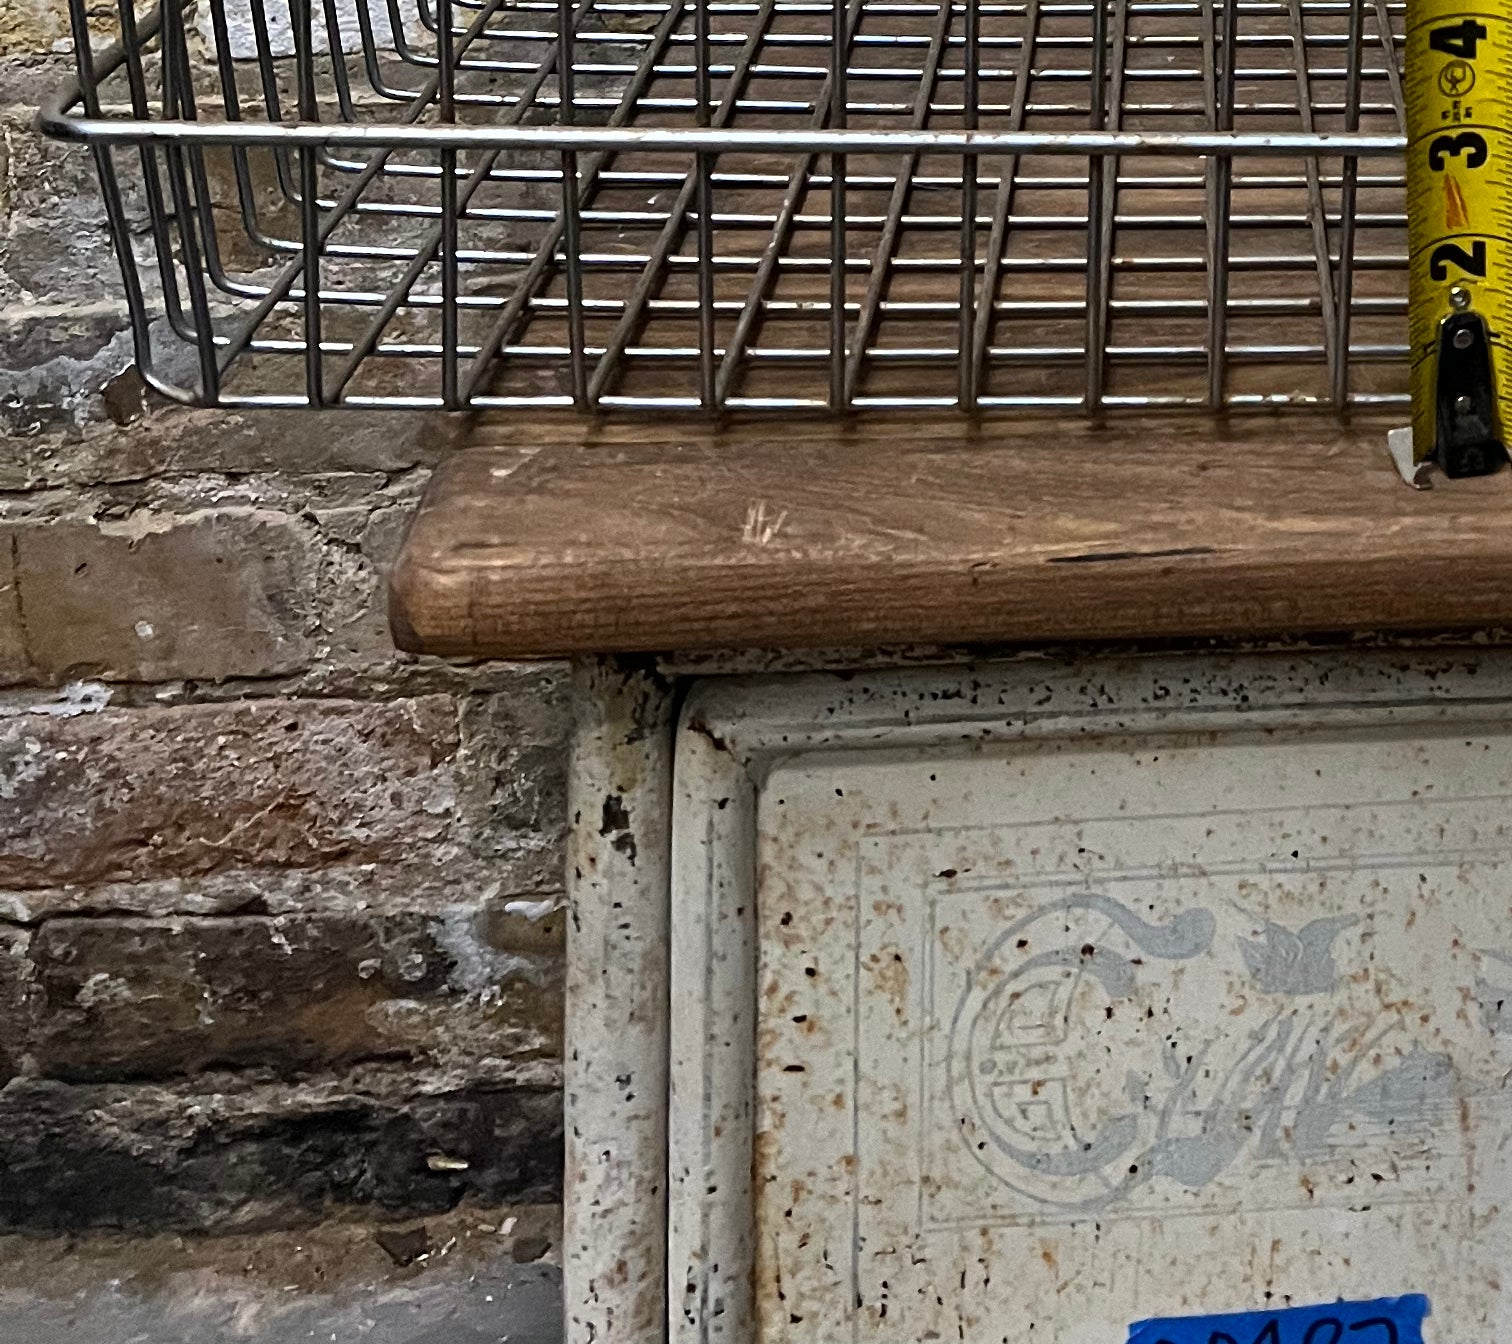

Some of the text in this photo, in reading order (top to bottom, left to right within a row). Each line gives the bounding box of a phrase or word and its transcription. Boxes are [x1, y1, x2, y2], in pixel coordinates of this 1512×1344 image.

[1430, 19, 1488, 60] 4
[1429, 131, 1488, 172] 3
[1430, 241, 1486, 282] 2
